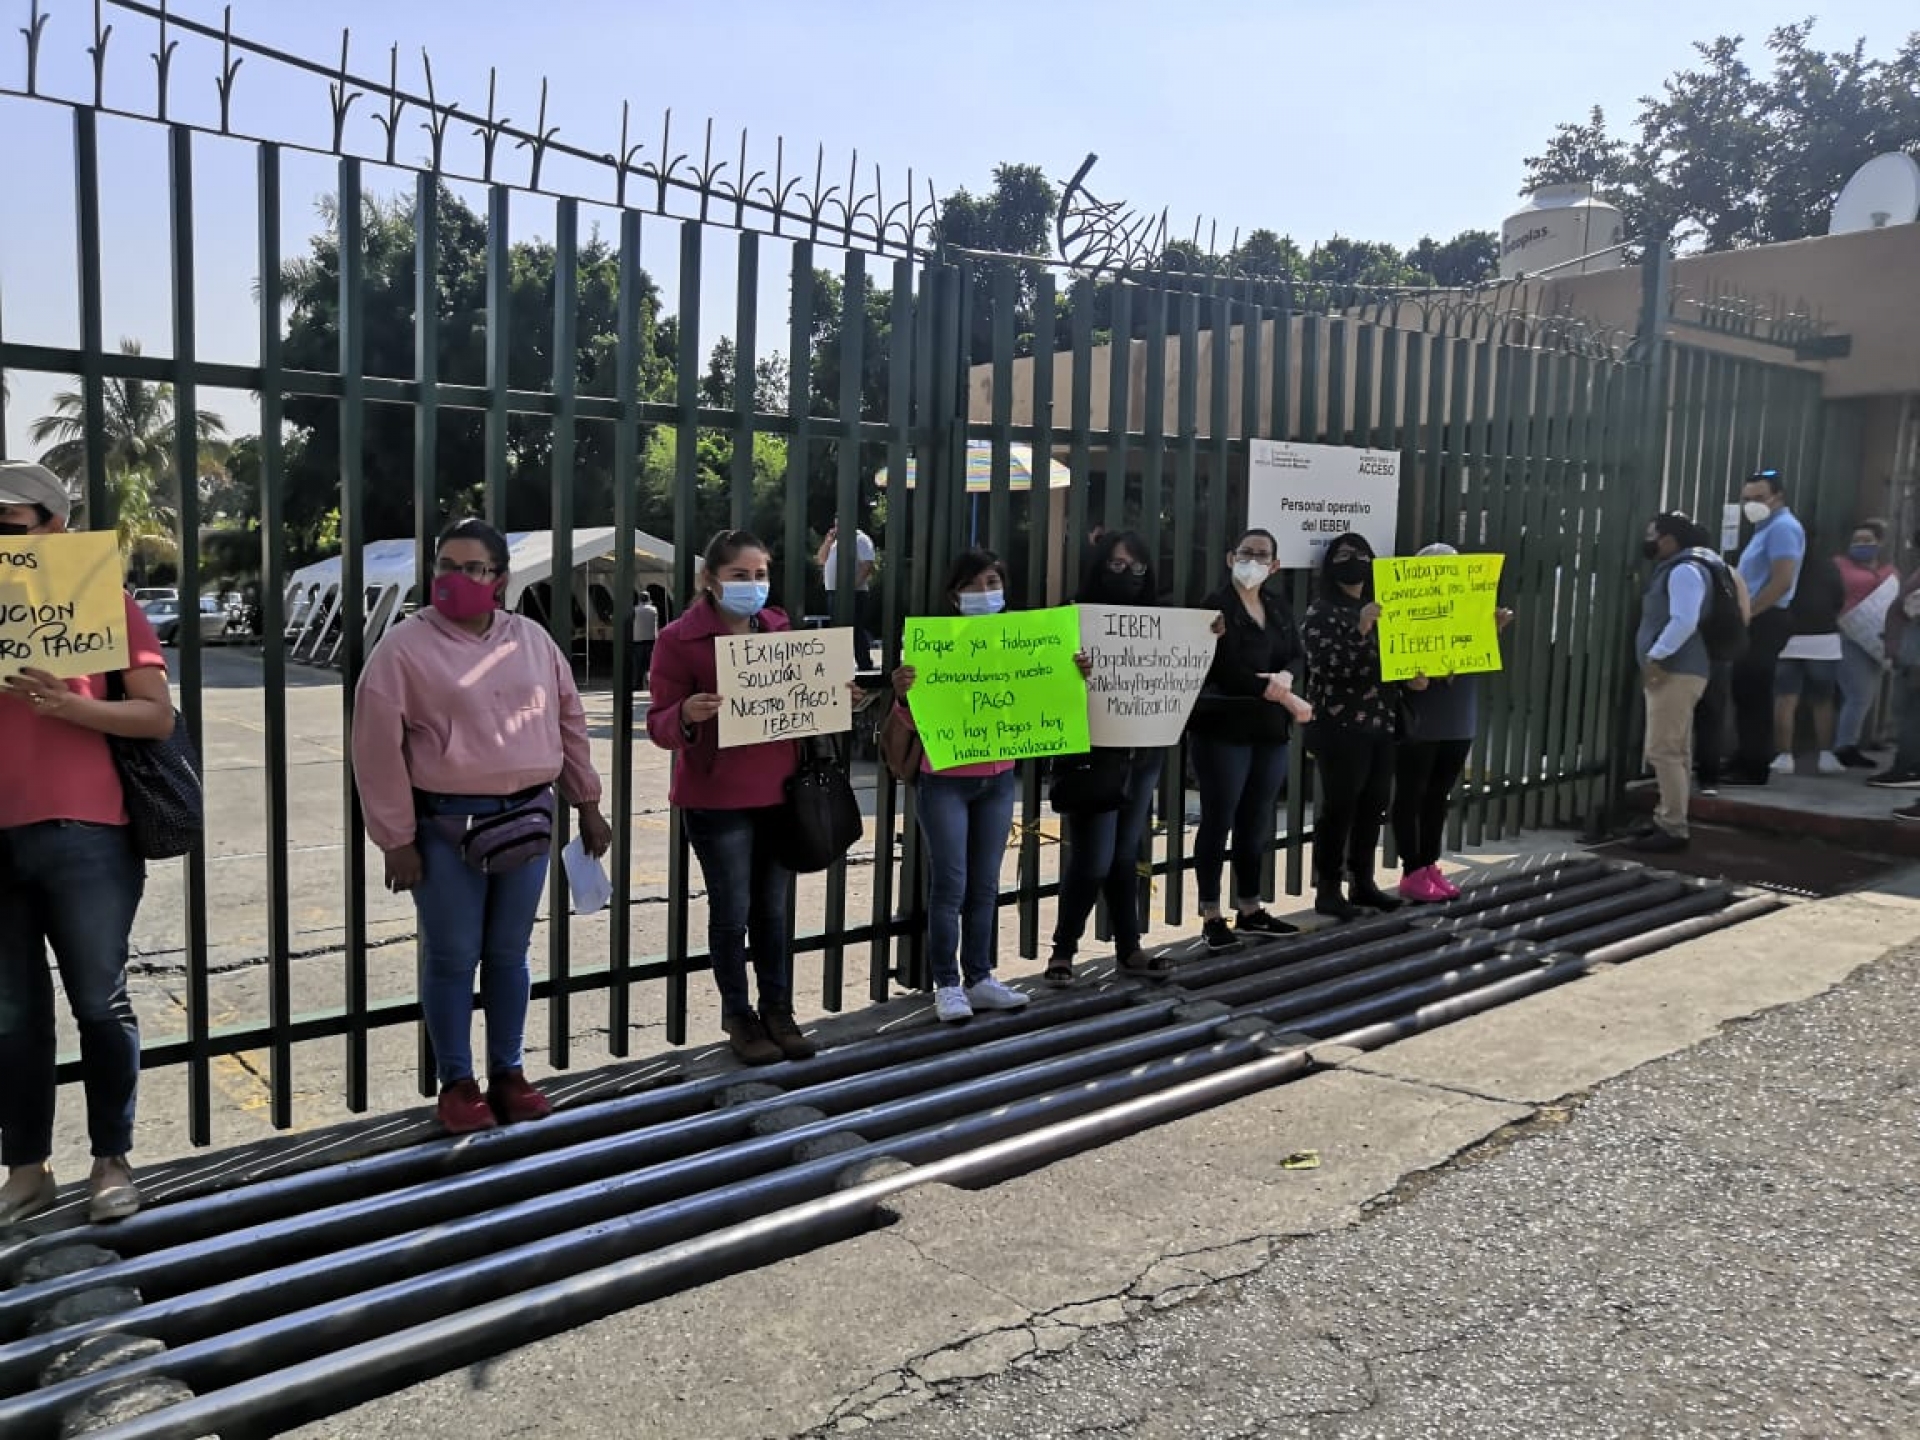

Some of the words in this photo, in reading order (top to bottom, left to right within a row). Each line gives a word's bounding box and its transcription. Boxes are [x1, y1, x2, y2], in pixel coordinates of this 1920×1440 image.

[1359, 462, 1396, 476] ACCESO
[1281, 498, 1326, 513] Personal
[1327, 501, 1371, 515] operativo
[1302, 519, 1317, 532] del
[1319, 520, 1351, 533] IEBEM
[1102, 613, 1162, 640] IEBEM
[28, 621, 114, 658] PAGO!
[912, 628, 955, 659] Porque
[970, 637, 988, 658] ya
[1000, 627, 1061, 656] trabajamos
[814, 662, 825, 678] A
[926, 667, 1010, 685] demandamos
[1015, 662, 1054, 681] nuestro
[731, 697, 786, 718] NUESTRO
[788, 683, 838, 711] PAGO!
[972, 690, 1015, 715] PAGO
[763, 711, 816, 736] IEBEM
[937, 726, 954, 741] no
[963, 719, 988, 742] hay
